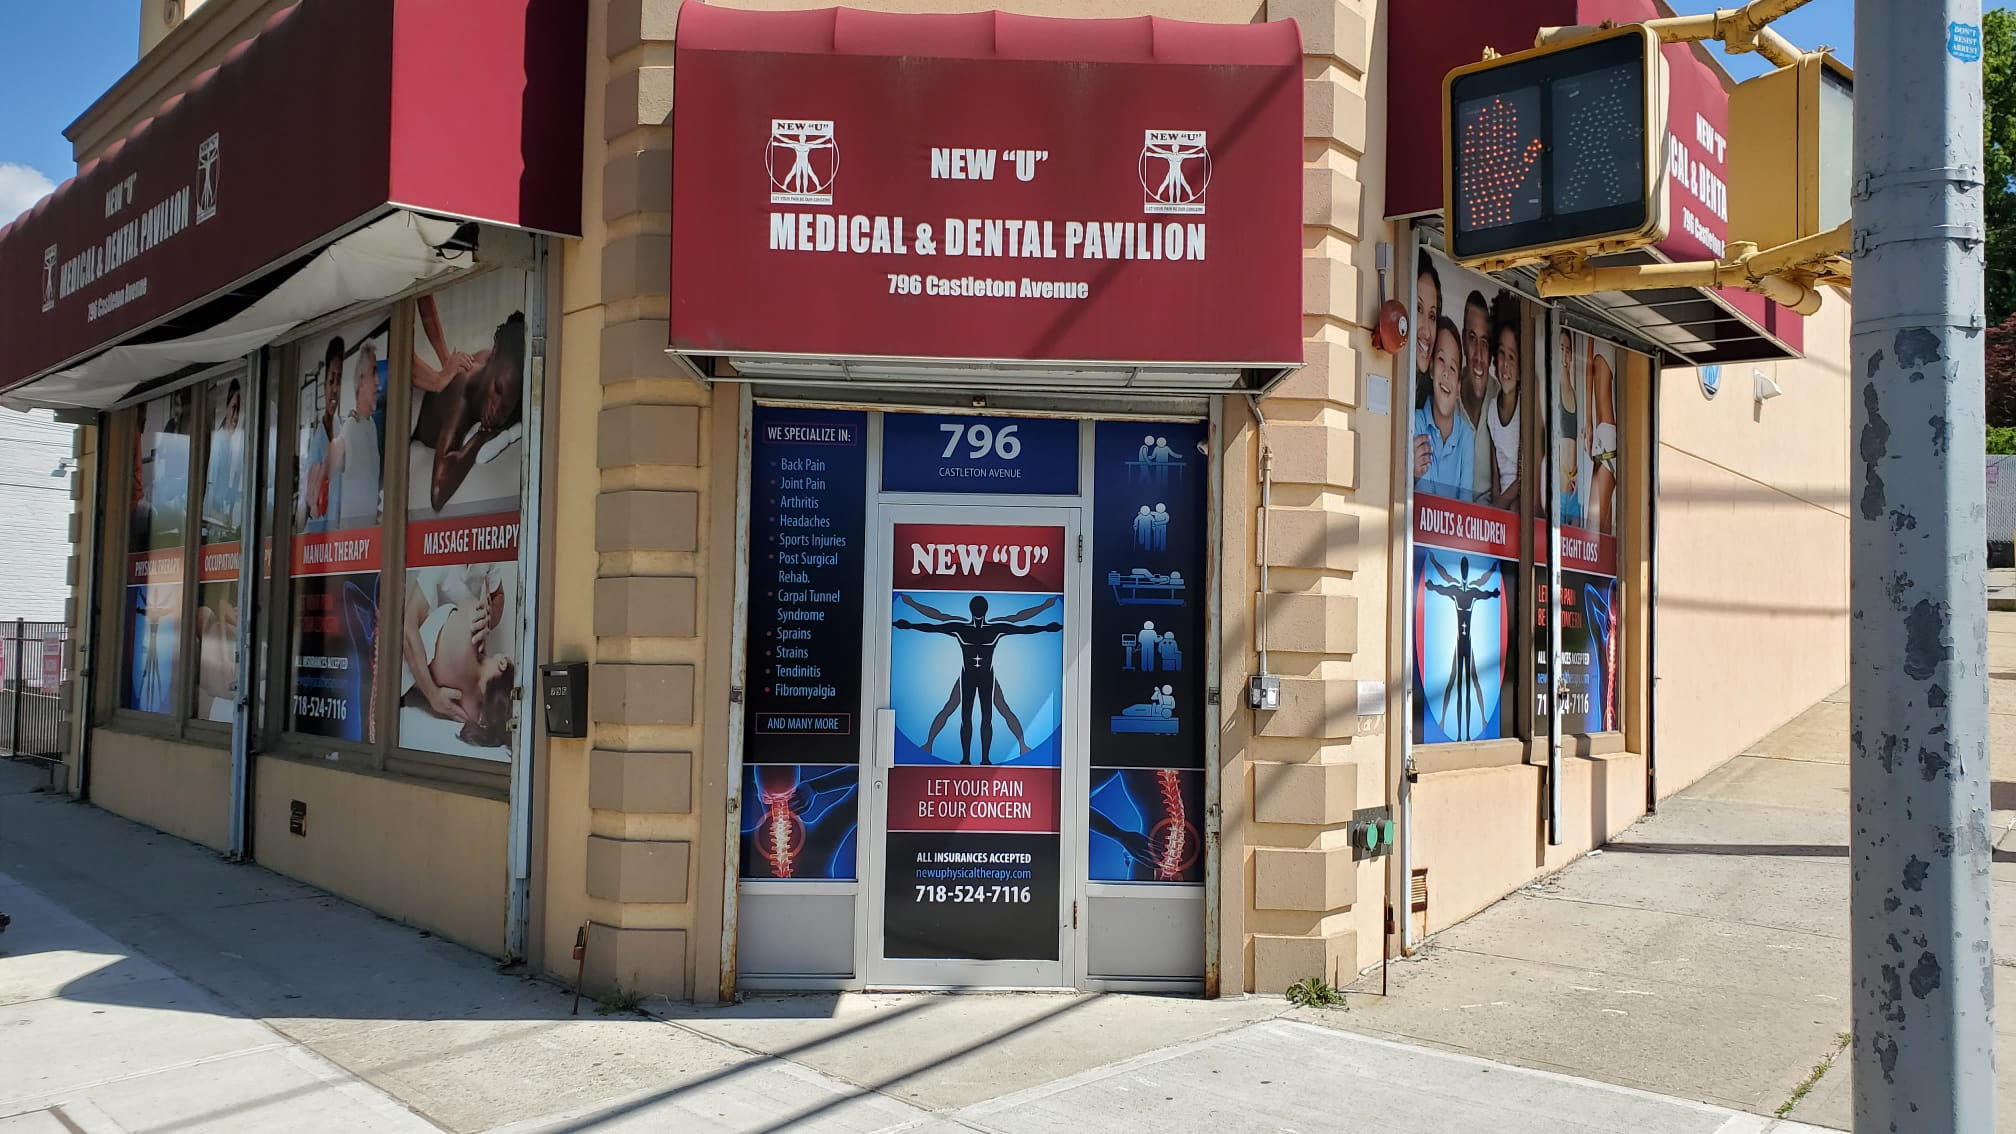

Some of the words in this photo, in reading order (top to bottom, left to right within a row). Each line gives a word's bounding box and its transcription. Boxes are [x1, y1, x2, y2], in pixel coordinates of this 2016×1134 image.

[1953, 34, 1977, 46] RESIST
[1953, 43, 1977, 55] ARREST
[777, 122, 806, 131] NEW
[1696, 111, 1714, 154] NEW
[1150, 132, 1178, 140] NEW
[931, 147, 997, 180] NEW
[1002, 149, 1049, 182] “U”
[105, 181, 124, 218] NEW
[1690, 160, 1698, 197] &
[1699, 161, 1728, 223] DENTA
[770, 212, 908, 254] MEDICAL
[915, 222, 936, 256] &
[945, 218, 1056, 258] DENTAL
[1065, 220, 1206, 260] PAVILION
[1683, 206, 1694, 235] 796
[1694, 216, 1722, 258] Castleton
[60, 244, 96, 300] MEDICAL
[96, 246, 103, 279] &
[104, 218, 138, 274] DENTAL
[140, 185, 190, 253] PAVILION
[887, 274, 922, 295] 796
[926, 275, 1016, 298] Castleton
[1020, 278, 1089, 299] Avenue
[88, 300, 98, 323] 796
[98, 288, 124, 318] Castleton
[125, 276, 147, 304] Avenue
[768, 426, 782, 440] WE
[784, 427, 836, 442] SPECIALIZE
[838, 429, 852, 442] IN:
[940, 423, 1021, 460] 796
[781, 458, 803, 470] Back
[806, 458, 826, 471] Pain
[938, 468, 986, 478] CASTLETON
[988, 468, 1022, 478] AVENUE
[780, 476, 803, 490] Joint
[806, 477, 826, 490] Pain
[780, 496, 819, 509] Arthritis
[780, 514, 830, 528] Headaches
[1420, 506, 1455, 536] ADULTS
[1456, 515, 1464, 538] &
[1465, 516, 1506, 545] CHILDREN
[423, 530, 469, 555] MASSAGE
[472, 524, 520, 552] THERAPY
[780, 532, 810, 547] Sports
[812, 534, 846, 550] Injuries
[304, 543, 333, 564] MANUAL
[334, 538, 370, 562] THERAPY
[1561, 536, 1582, 560] EIGHT
[1583, 542, 1598, 563] LOSS
[135, 560, 158, 577] PHYSICAL
[204, 552, 240, 572] OCCUPATION
[779, 552, 800, 565] Post
[802, 552, 838, 568] Surgical
[911, 543, 988, 576] NEW
[992, 544, 1049, 577] “U”
[778, 570, 810, 584] Rehab.
[778, 588, 808, 605] Carpal
[810, 590, 840, 603] Tunnel
[777, 608, 825, 624] Syndrome
[1537, 608, 1546, 626] BE
[1561, 611, 1582, 628] ONCERN
[776, 626, 812, 642] Sprains
[776, 646, 809, 659] Strains
[1538, 650, 1546, 665] ALL
[776, 664, 821, 678] Tendinitis
[776, 684, 836, 700] Fibromyalgia
[293, 696, 348, 720] 718-524-7116
[768, 718, 786, 730] AND
[787, 718, 813, 730] MANY
[814, 718, 839, 730] MORE
[927, 779, 950, 796] LET
[953, 780, 989, 797] YOUR
[993, 780, 1024, 797] PAIN
[918, 801, 935, 818] BE
[938, 801, 967, 818] OUR
[970, 802, 1032, 819] CONCERN
[916, 852, 932, 863] ALL
[934, 852, 988, 863] INSURANCES
[989, 853, 1032, 864] ACCEPTED
[915, 867, 1032, 881] newuphysicaltherapy.com
[915, 885, 1031, 903] 718-524-7116
